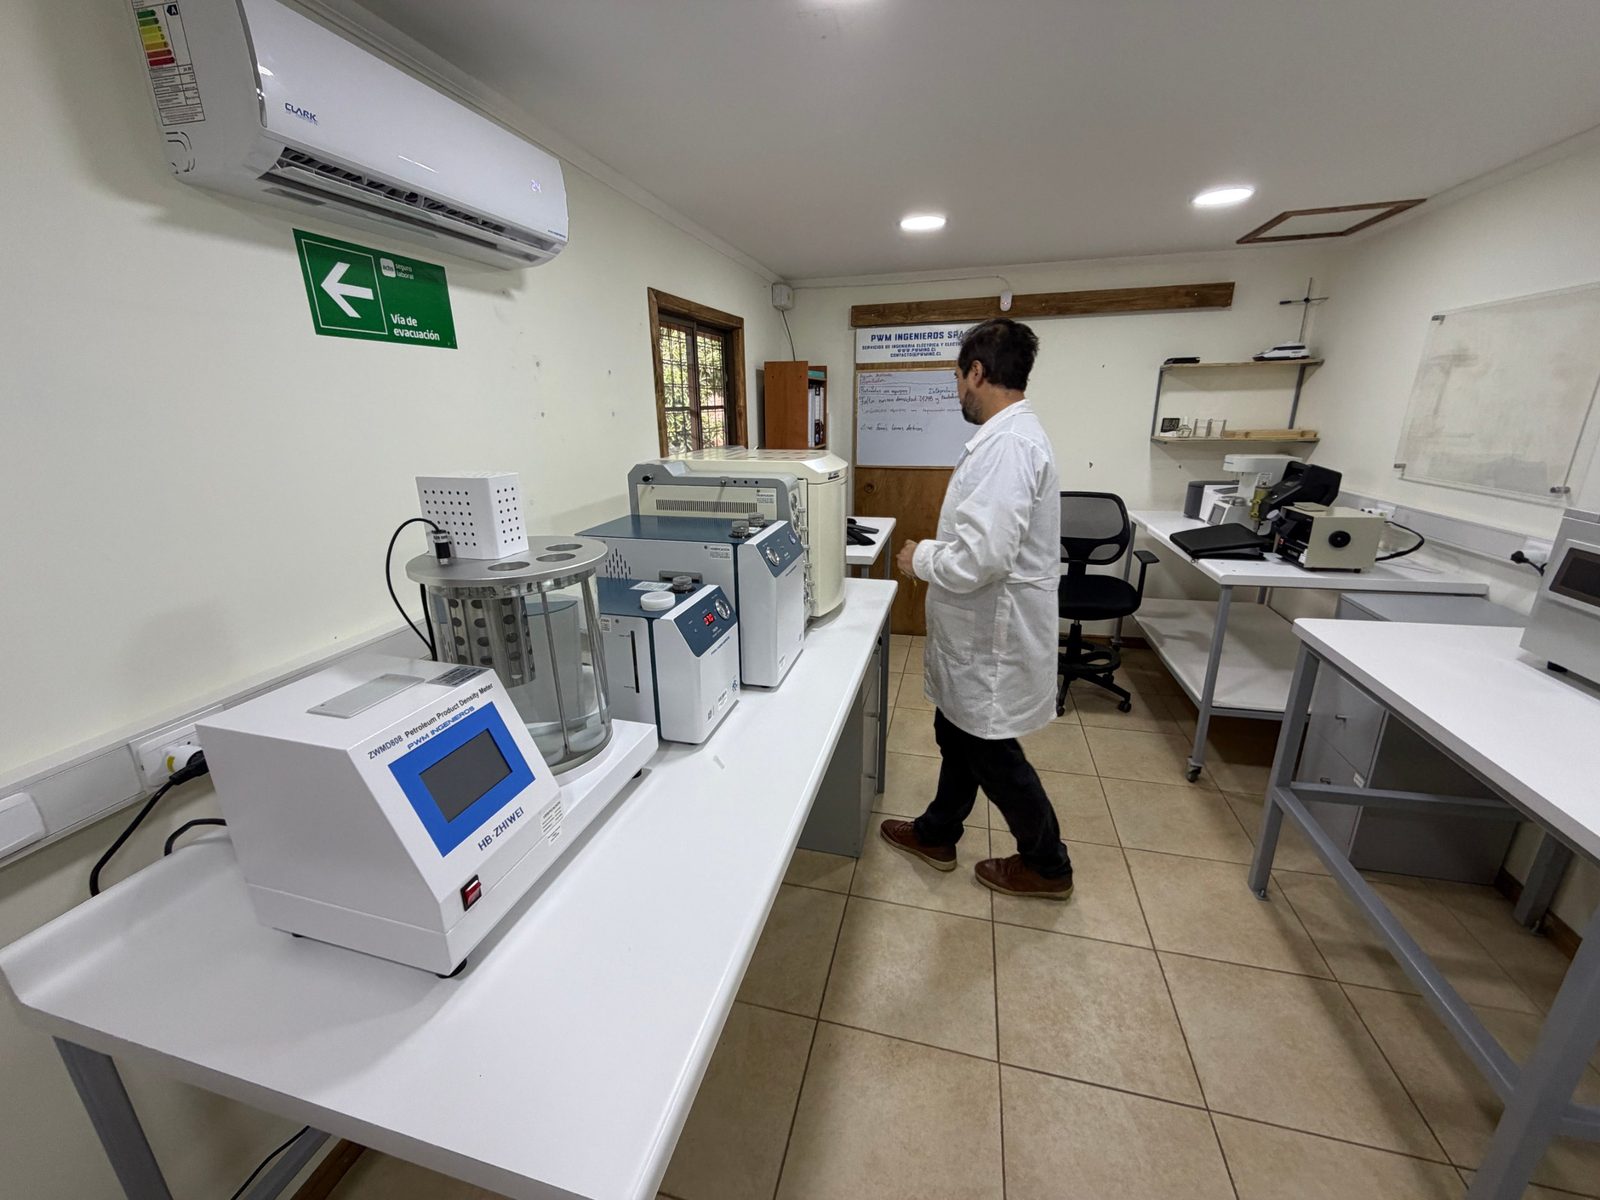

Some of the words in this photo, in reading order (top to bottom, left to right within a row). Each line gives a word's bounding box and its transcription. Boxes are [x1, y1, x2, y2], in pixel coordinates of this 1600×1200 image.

[285, 102, 317, 121] CLARK
[390, 313, 406, 325] Vía
[406, 315, 418, 327] de
[393, 328, 440, 341] evacuación
[870, 333, 892, 343] PWM
[894, 331, 944, 341] INGENIEROS
[368, 735, 403, 760] ZWMD808
[404, 717, 437, 738] Petroleum
[437, 703, 460, 719] Product
[459, 691, 480, 706] Density
[479, 683, 494, 694] Meter
[407, 733, 430, 750] PWM
